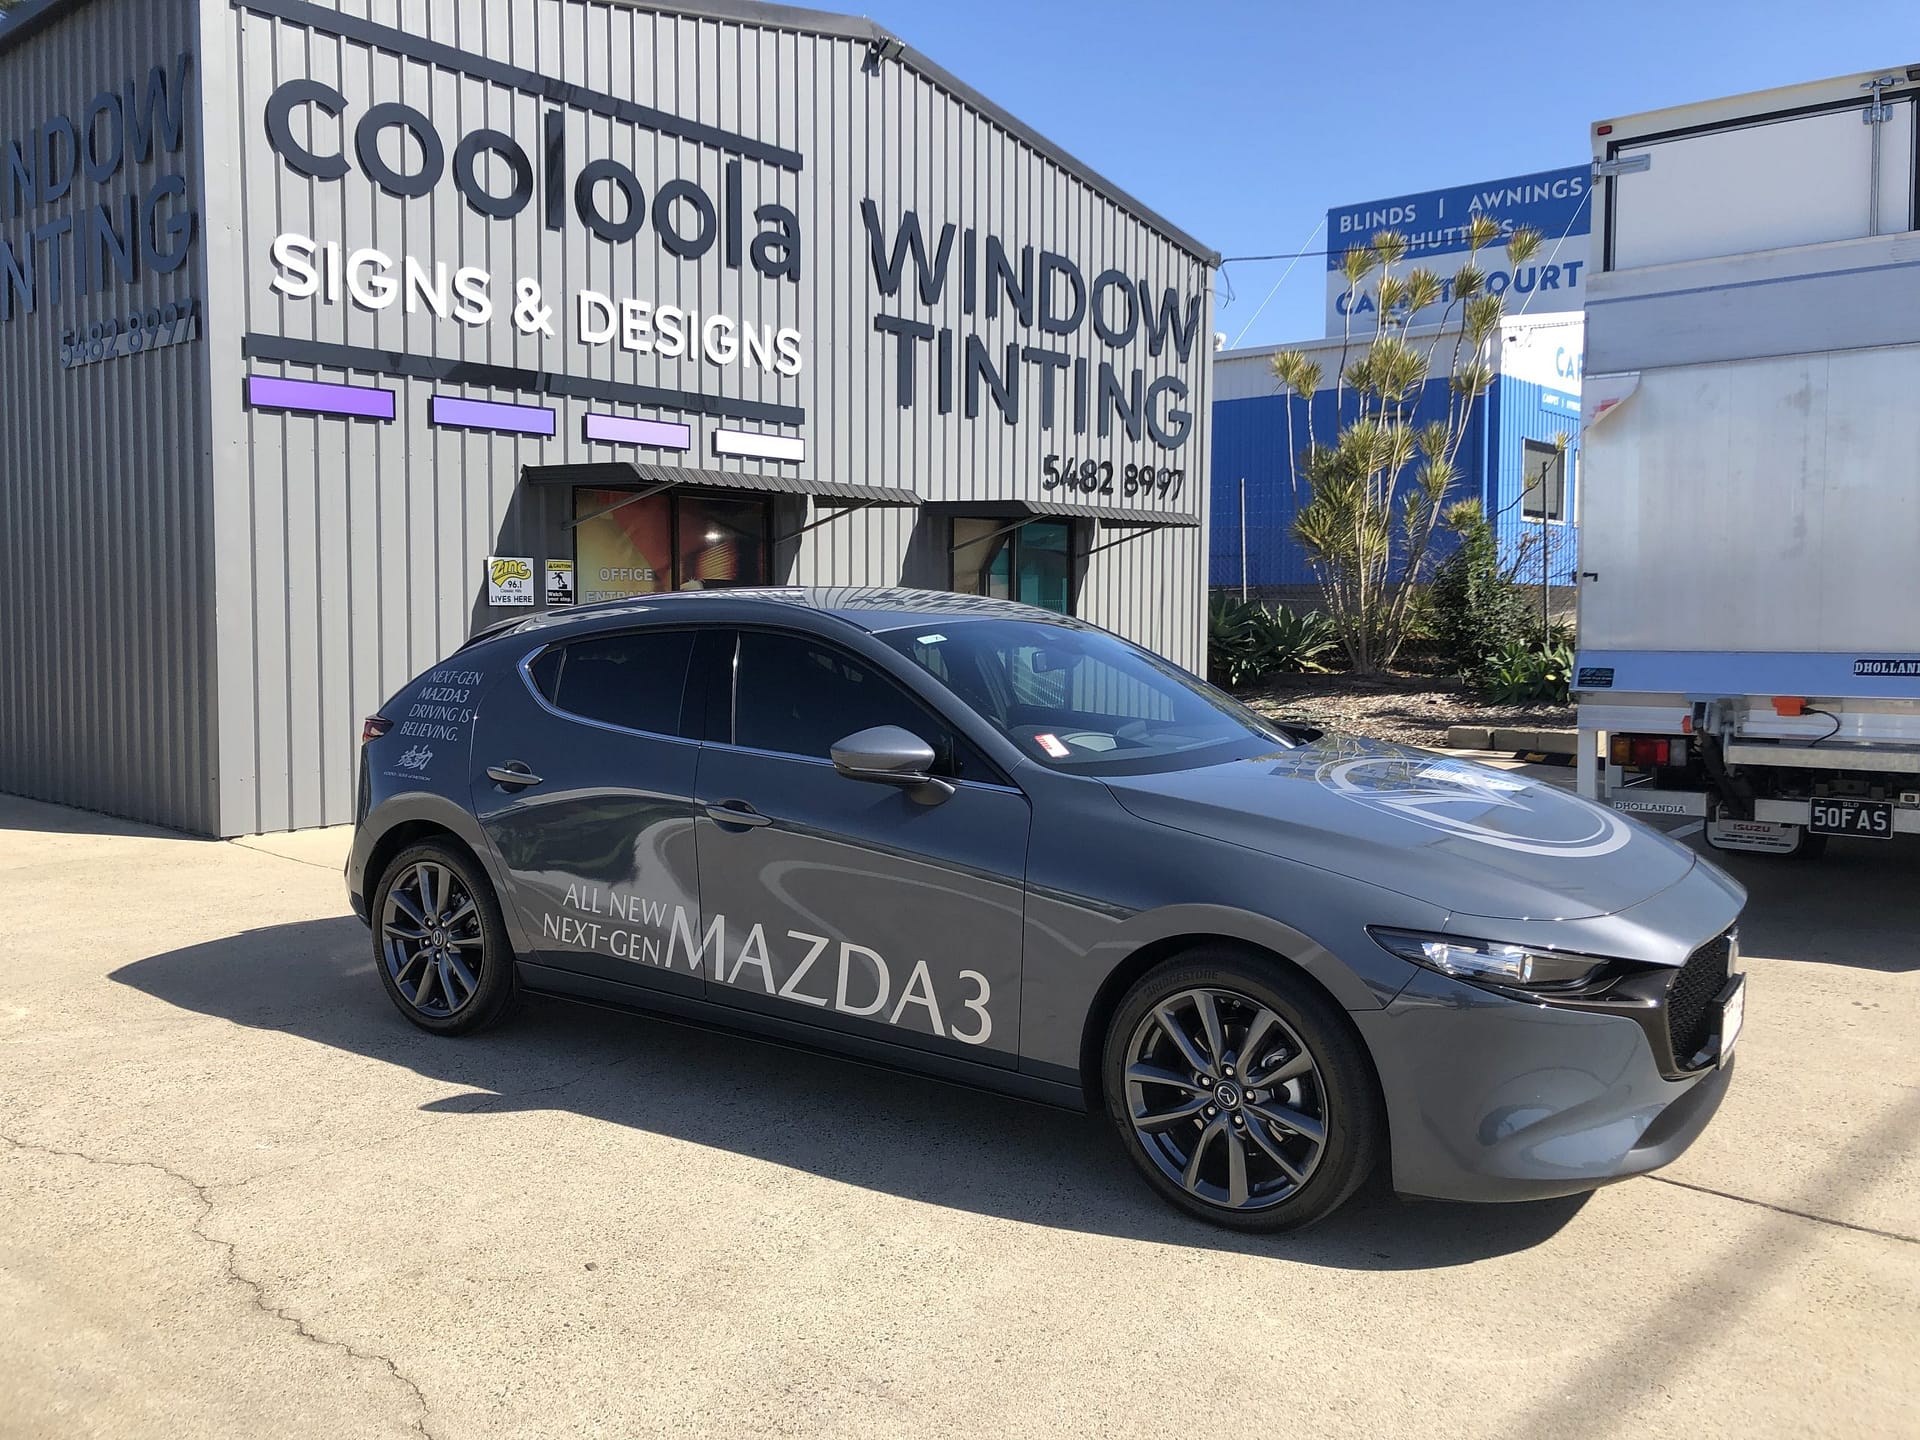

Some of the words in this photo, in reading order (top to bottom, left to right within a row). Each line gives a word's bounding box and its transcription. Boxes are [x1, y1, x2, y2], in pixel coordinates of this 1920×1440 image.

[1340, 204, 1416, 233] BLINDS
[1467, 177, 1583, 213] AWNINGS
[1400, 219, 1514, 252] SHUTTS
[860, 197, 1201, 363] WINDOW
[1473, 261, 1583, 299] OURT
[271, 233, 494, 327] SIGNS
[514, 277, 555, 336] &
[579, 289, 802, 376] DESIGNS
[61, 317, 119, 369] 5482
[127, 298, 194, 353] 8997
[874, 313, 1193, 450] TINTING
[1043, 455, 1114, 494] 5482
[1124, 463, 1185, 501] 8997
[507, 580, 522, 588] 96.1
[600, 568, 653, 581] OFFICE
[417, 687, 470, 703] MAZDA3
[428, 670, 484, 685] NEXT-GEN
[400, 721, 458, 742] BELIEVING.
[408, 703, 459, 721] DRIVING
[459, 708, 472, 723] IS
[1615, 801, 1686, 814] DHOLLANDIA
[1733, 823, 1771, 832] ISUZU
[562, 882, 602, 914] ALL
[609, 891, 667, 928] NEW
[543, 912, 661, 965] NEXT-GEN
[664, 905, 993, 1045] MAZDA3
